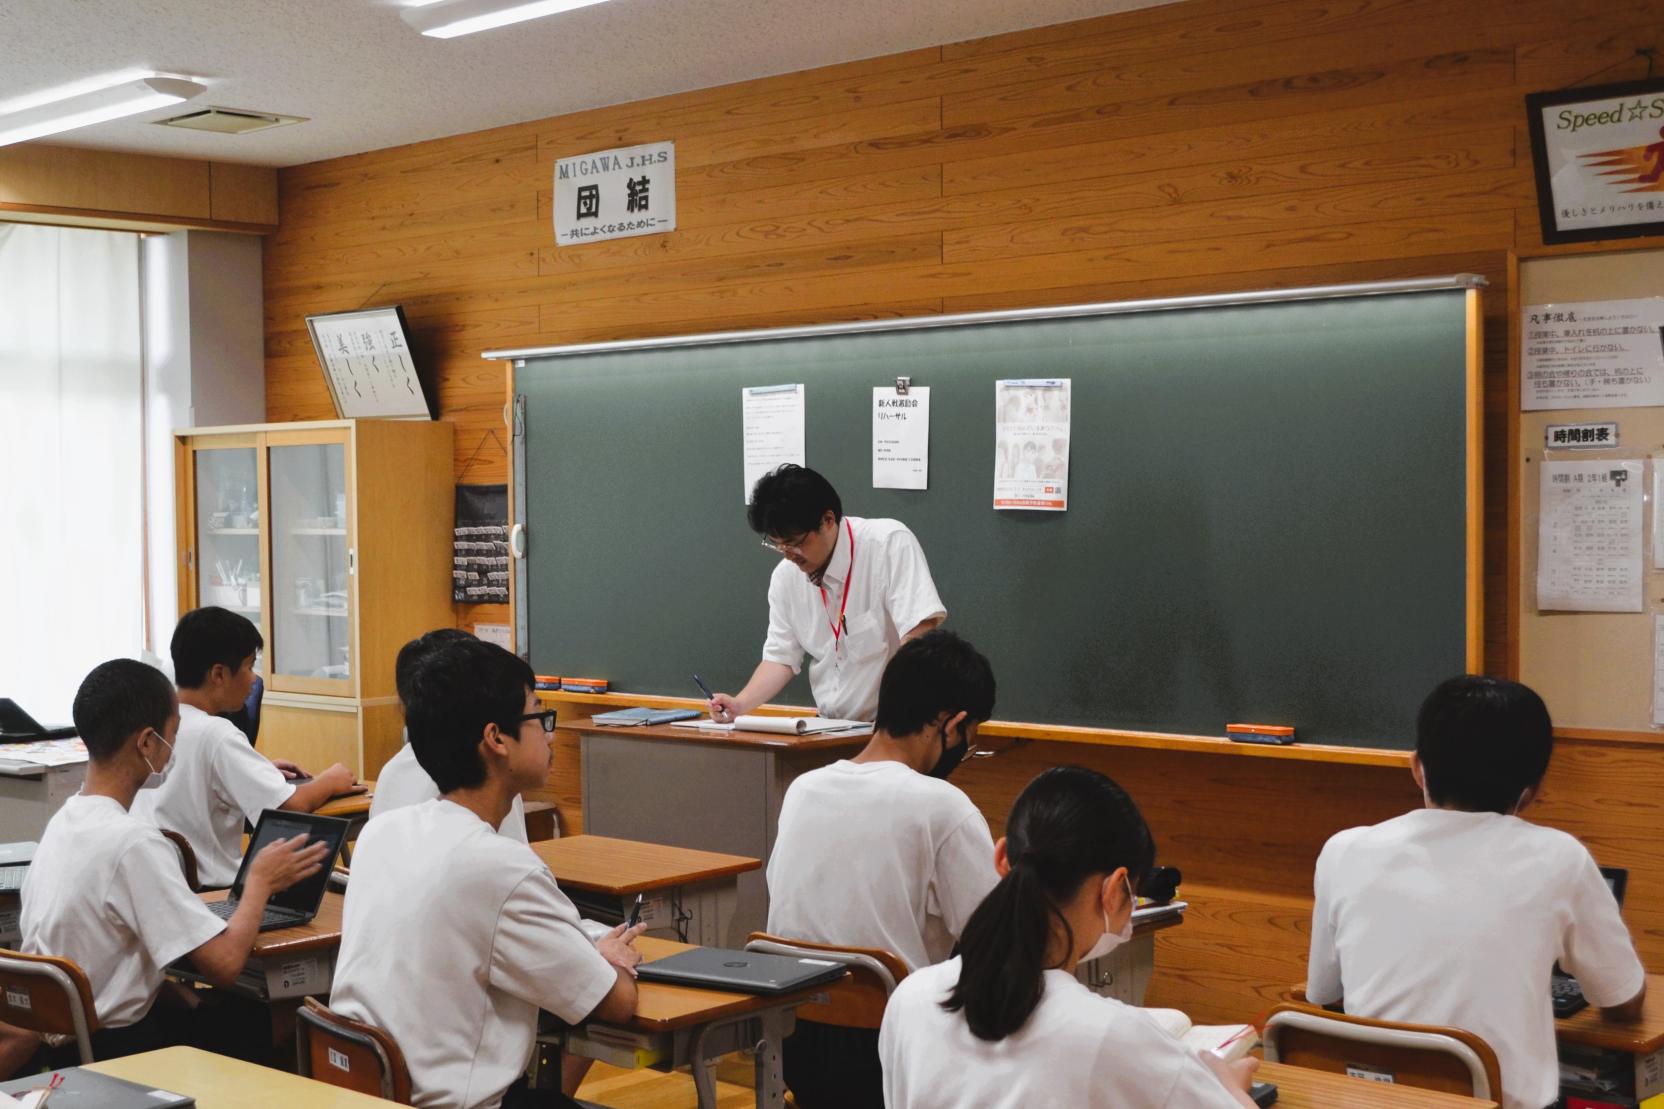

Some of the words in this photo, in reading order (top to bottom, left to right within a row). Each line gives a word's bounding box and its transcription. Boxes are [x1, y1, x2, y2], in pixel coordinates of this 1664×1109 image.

[558, 155, 622, 180] MIGAWA
[878, 412, 907, 421] リハーサル
[1553, 427, 1610, 443] 時間割表
